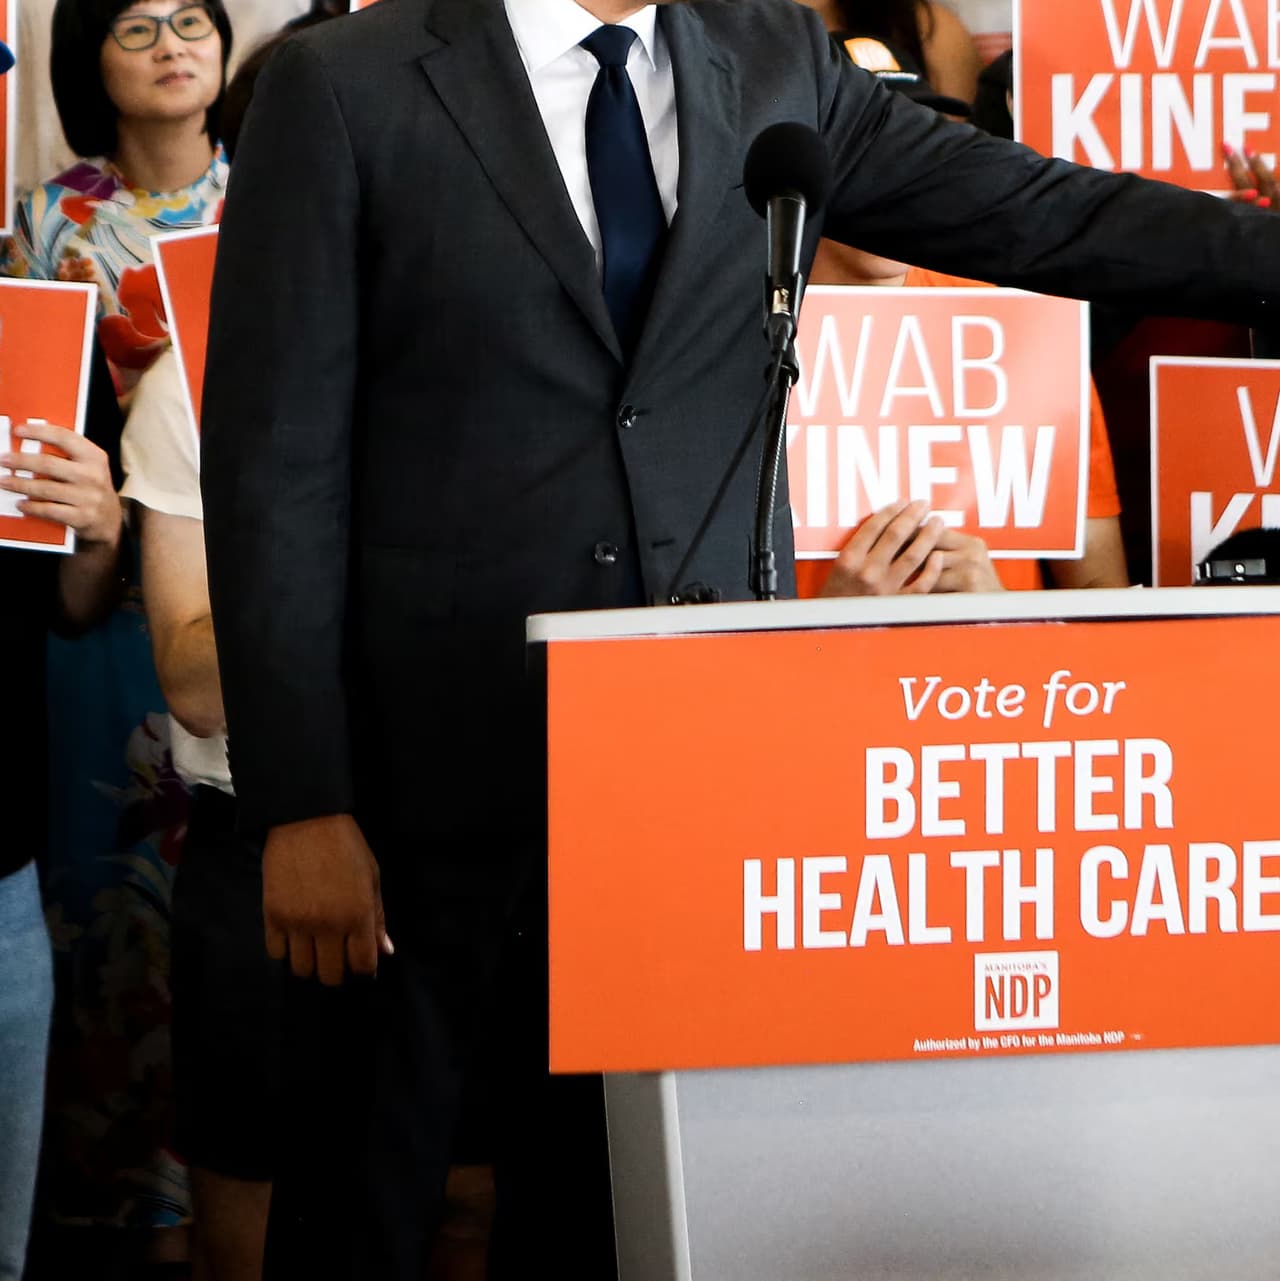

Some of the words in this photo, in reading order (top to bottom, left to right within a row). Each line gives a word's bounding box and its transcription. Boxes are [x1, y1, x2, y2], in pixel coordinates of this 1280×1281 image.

[795, 315, 1010, 419] WAB
[899, 676, 1027, 721] Vote
[1041, 669, 1127, 728] for
[864, 737, 1175, 840] BETTER
[742, 849, 1056, 952] HEALTH
[983, 961, 1048, 973] MANITOBA'S
[984, 973, 1052, 1020] NDP
[913, 1034, 967, 1053] Authorized
[967, 1035, 981, 1052] by
[982, 1034, 1000, 1050] the
[999, 1033, 1020, 1049] CFO
[1021, 1032, 1037, 1048] for
[1038, 1032, 1055, 1047] the
[1055, 1031, 1103, 1047] Manitoba
[1103, 1030, 1126, 1045] NDP
